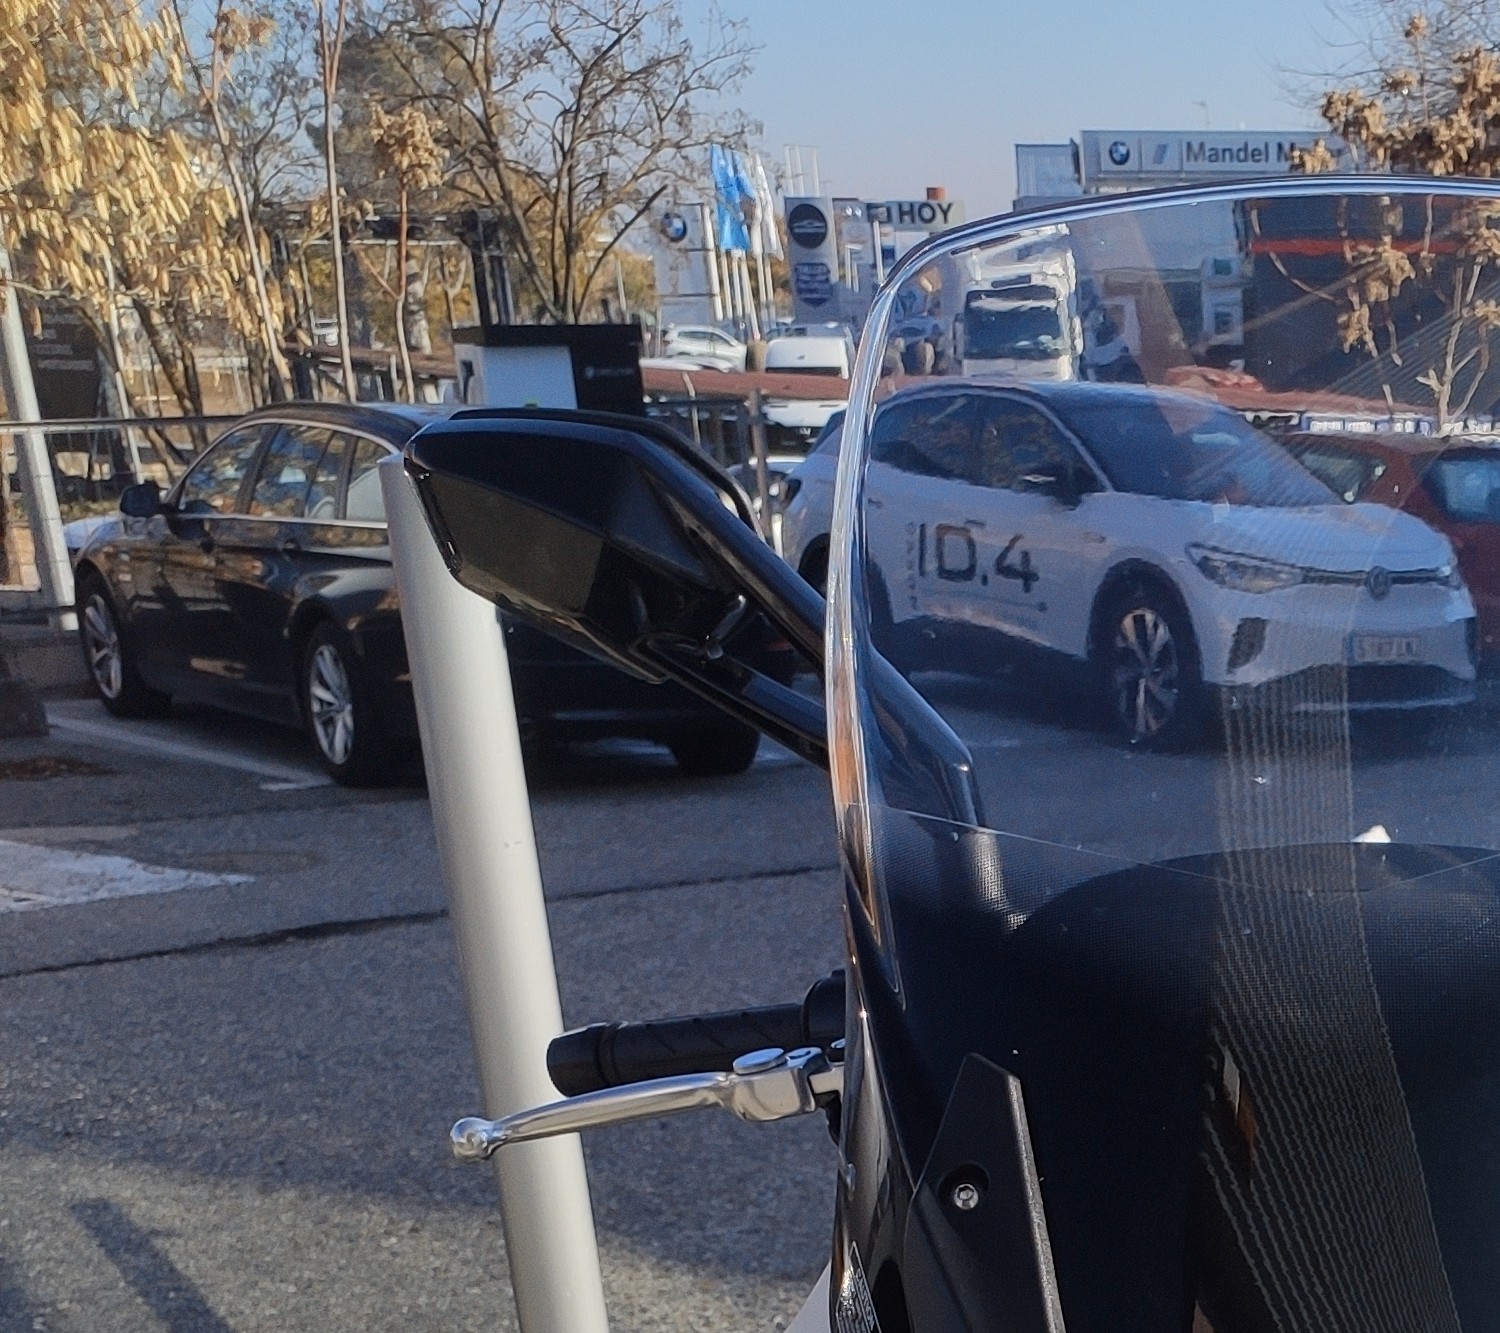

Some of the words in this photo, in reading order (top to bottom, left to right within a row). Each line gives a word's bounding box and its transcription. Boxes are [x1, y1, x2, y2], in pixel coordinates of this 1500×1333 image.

[1185, 141, 1269, 164] Mandel
[918, 523, 1040, 593] ID.4
[855, 1267, 876, 1332] CAUTION
